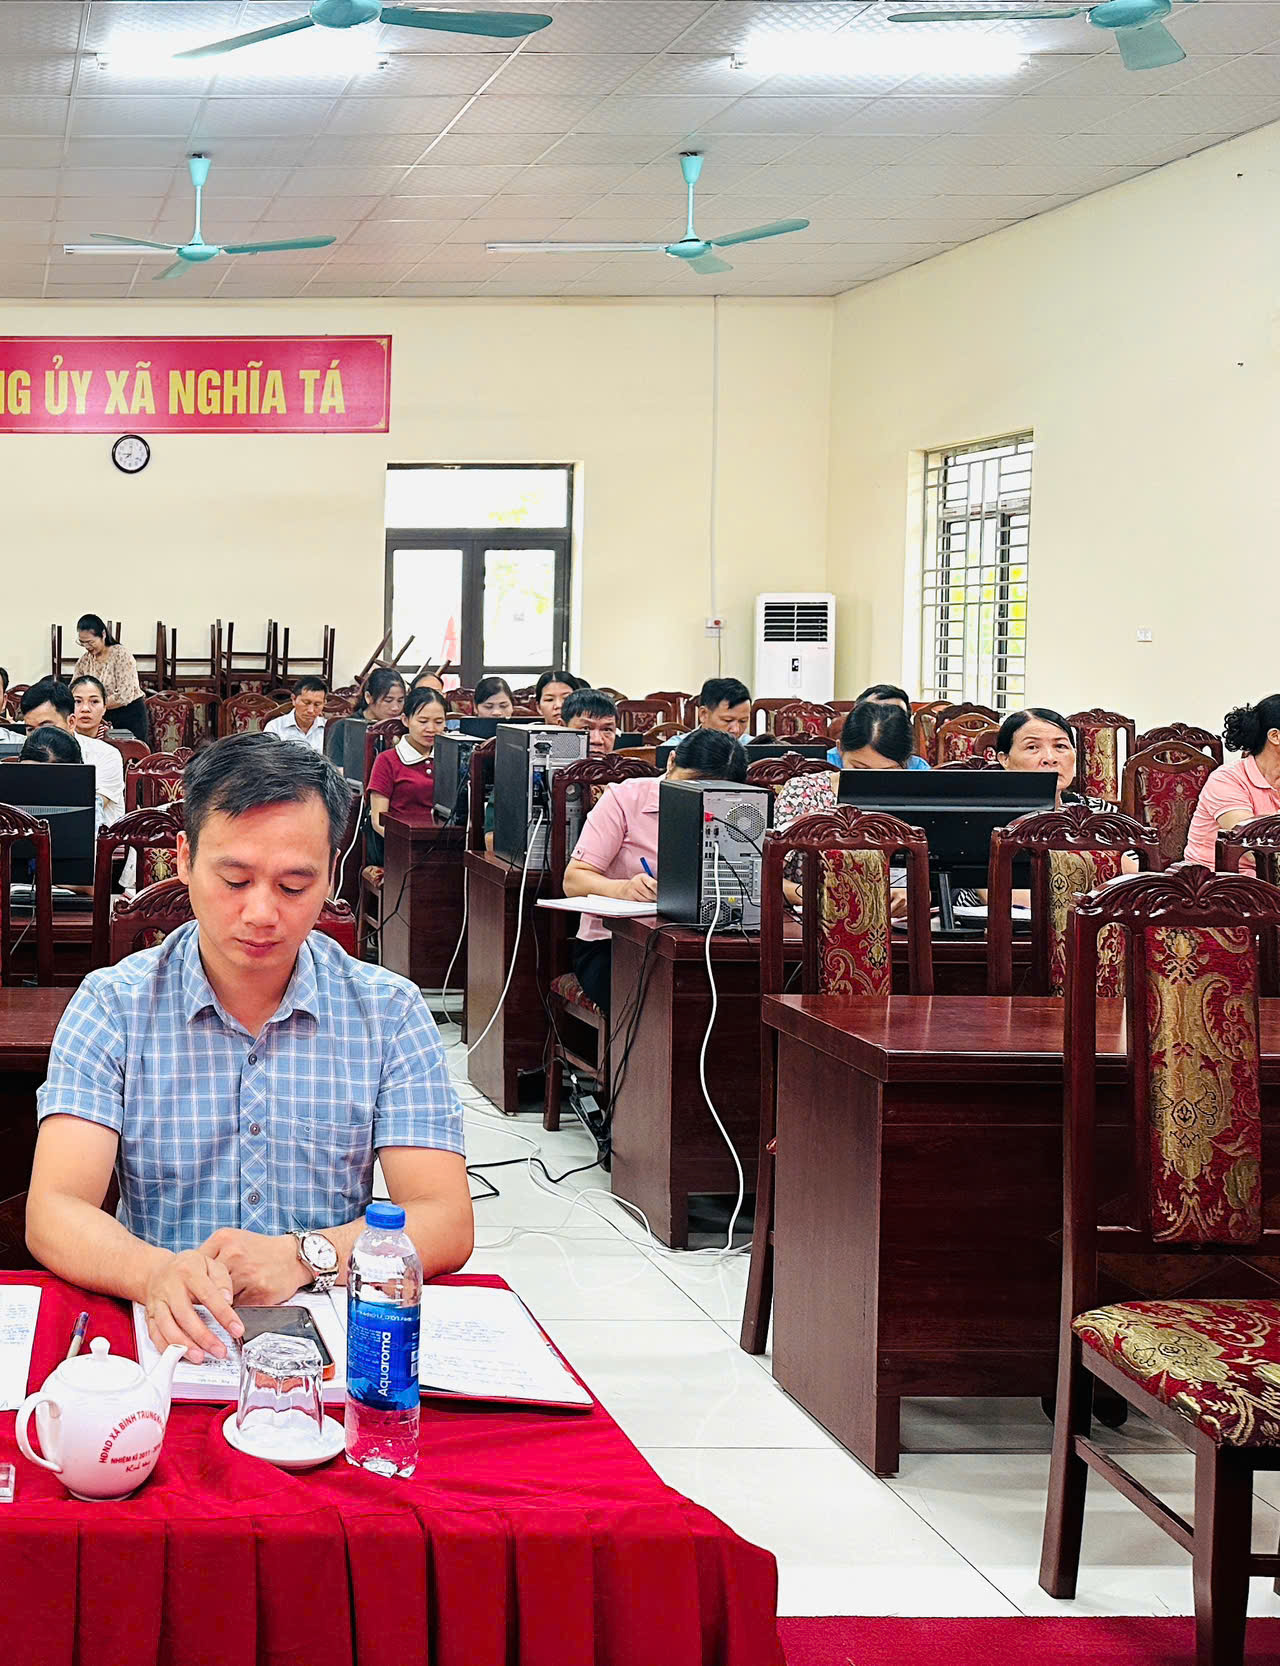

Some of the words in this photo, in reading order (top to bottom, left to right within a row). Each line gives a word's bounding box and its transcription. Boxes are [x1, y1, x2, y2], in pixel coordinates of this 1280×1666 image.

[44, 354, 93, 415] ỦY
[104, 361, 156, 415] XÃ
[168, 361, 287, 415] NGHĨA
[298, 360, 347, 415] TÁ
[377, 1331, 391, 1397] Aquaroma
